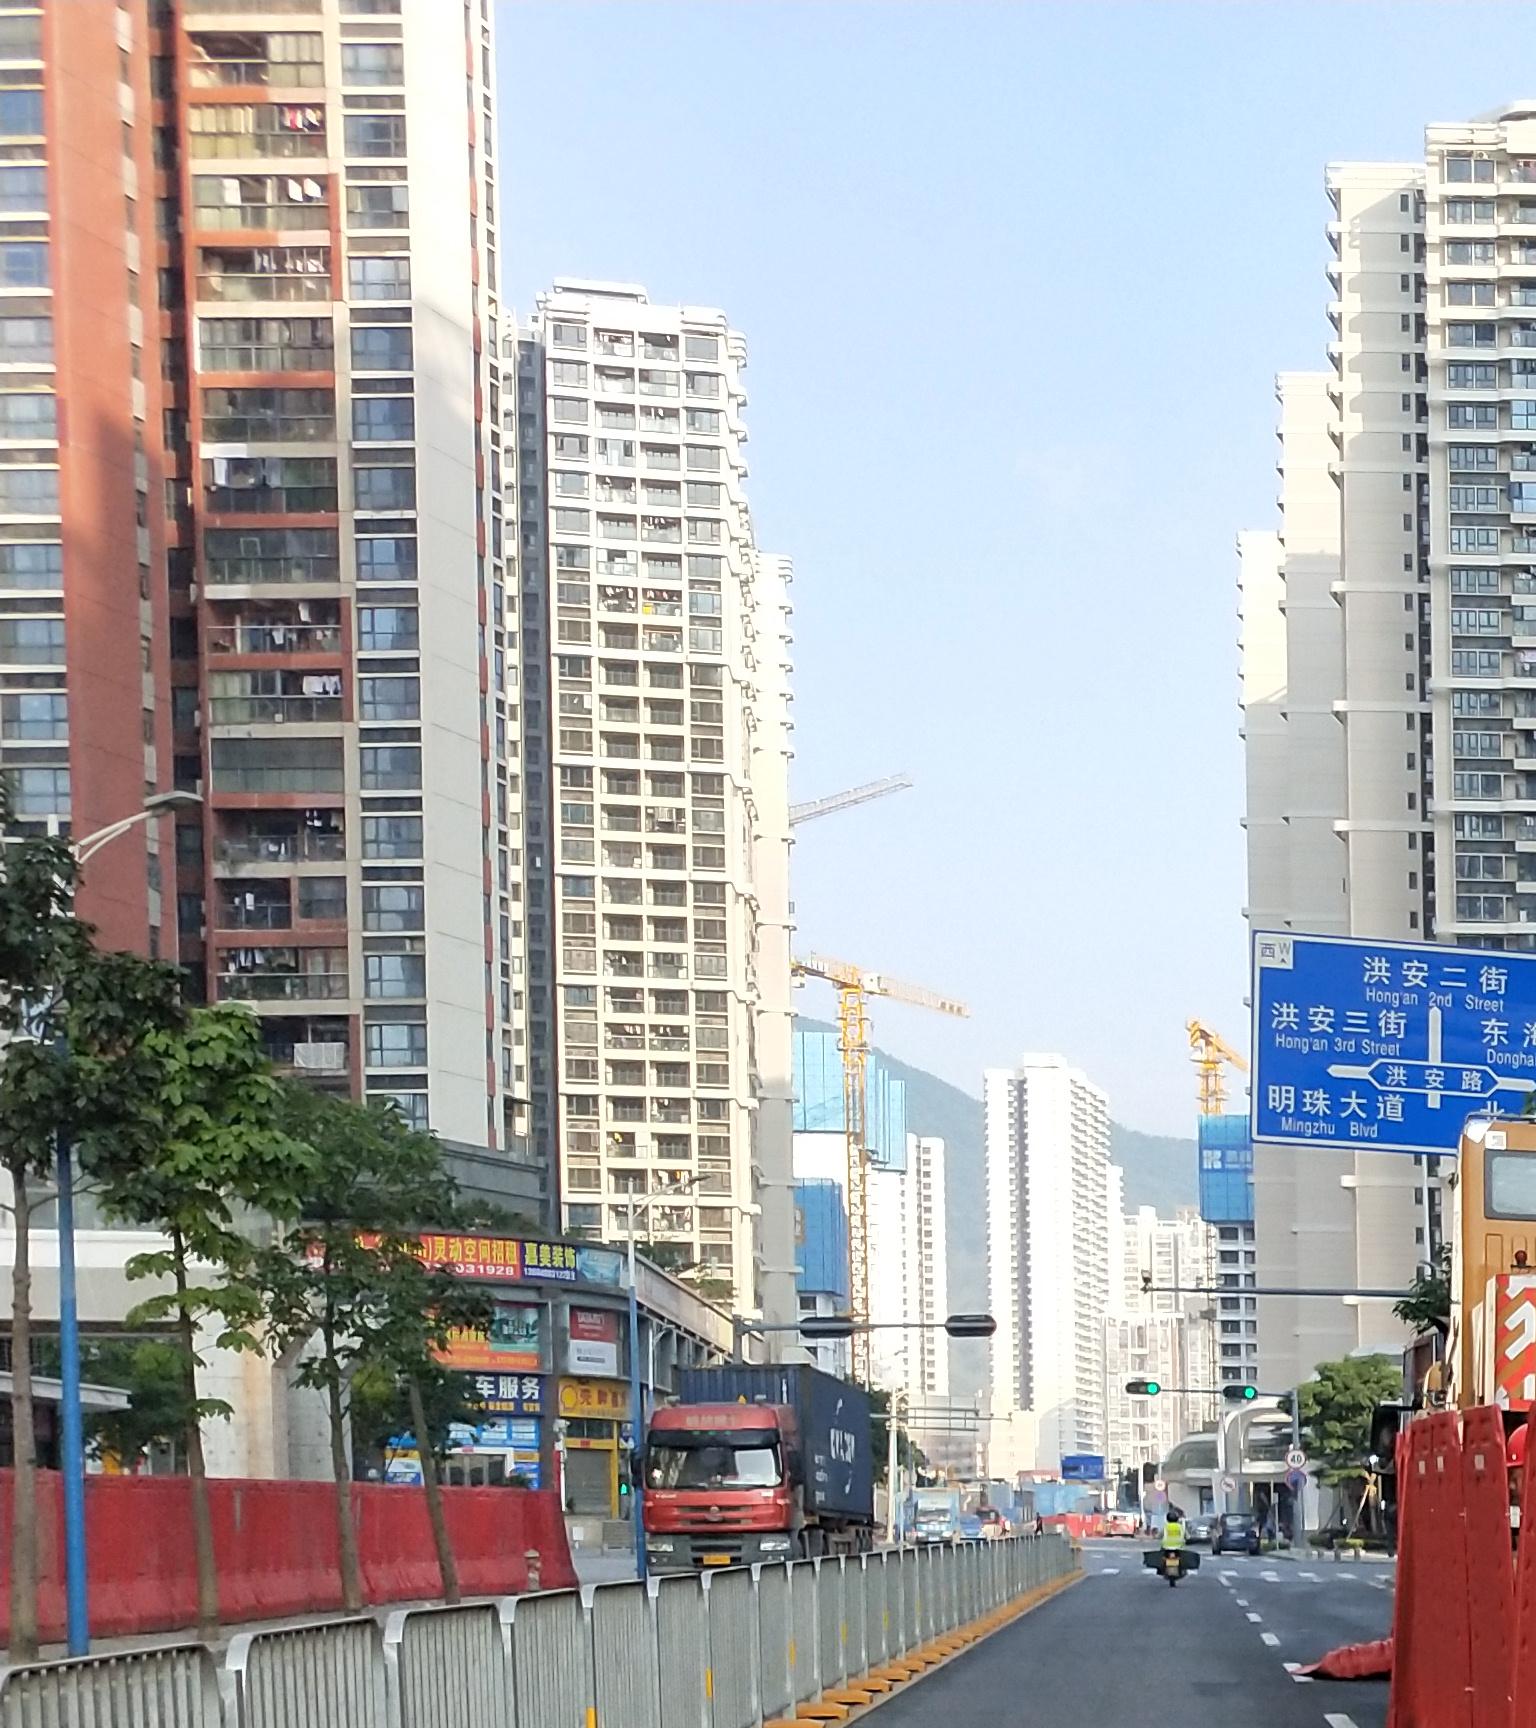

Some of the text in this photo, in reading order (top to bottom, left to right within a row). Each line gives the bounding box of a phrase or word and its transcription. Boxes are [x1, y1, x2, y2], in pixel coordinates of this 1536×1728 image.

[1259, 943, 1276, 958] 西
[1279, 942, 1291, 956] W
[1363, 956, 1508, 995] 洪安二街
[1366, 987, 1504, 1014] Hong'an 2nd Street
[1271, 1002, 1407, 1039] 洪安三街
[1275, 1033, 1400, 1056] Hong'an 3rd Street
[1386, 1065, 1484, 1092] 洪安路
[1268, 1085, 1406, 1122] 明珠大道
[1281, 1117, 1378, 1138] Mingzhu Blvd
[463, 1375, 541, 1401] 车服务
